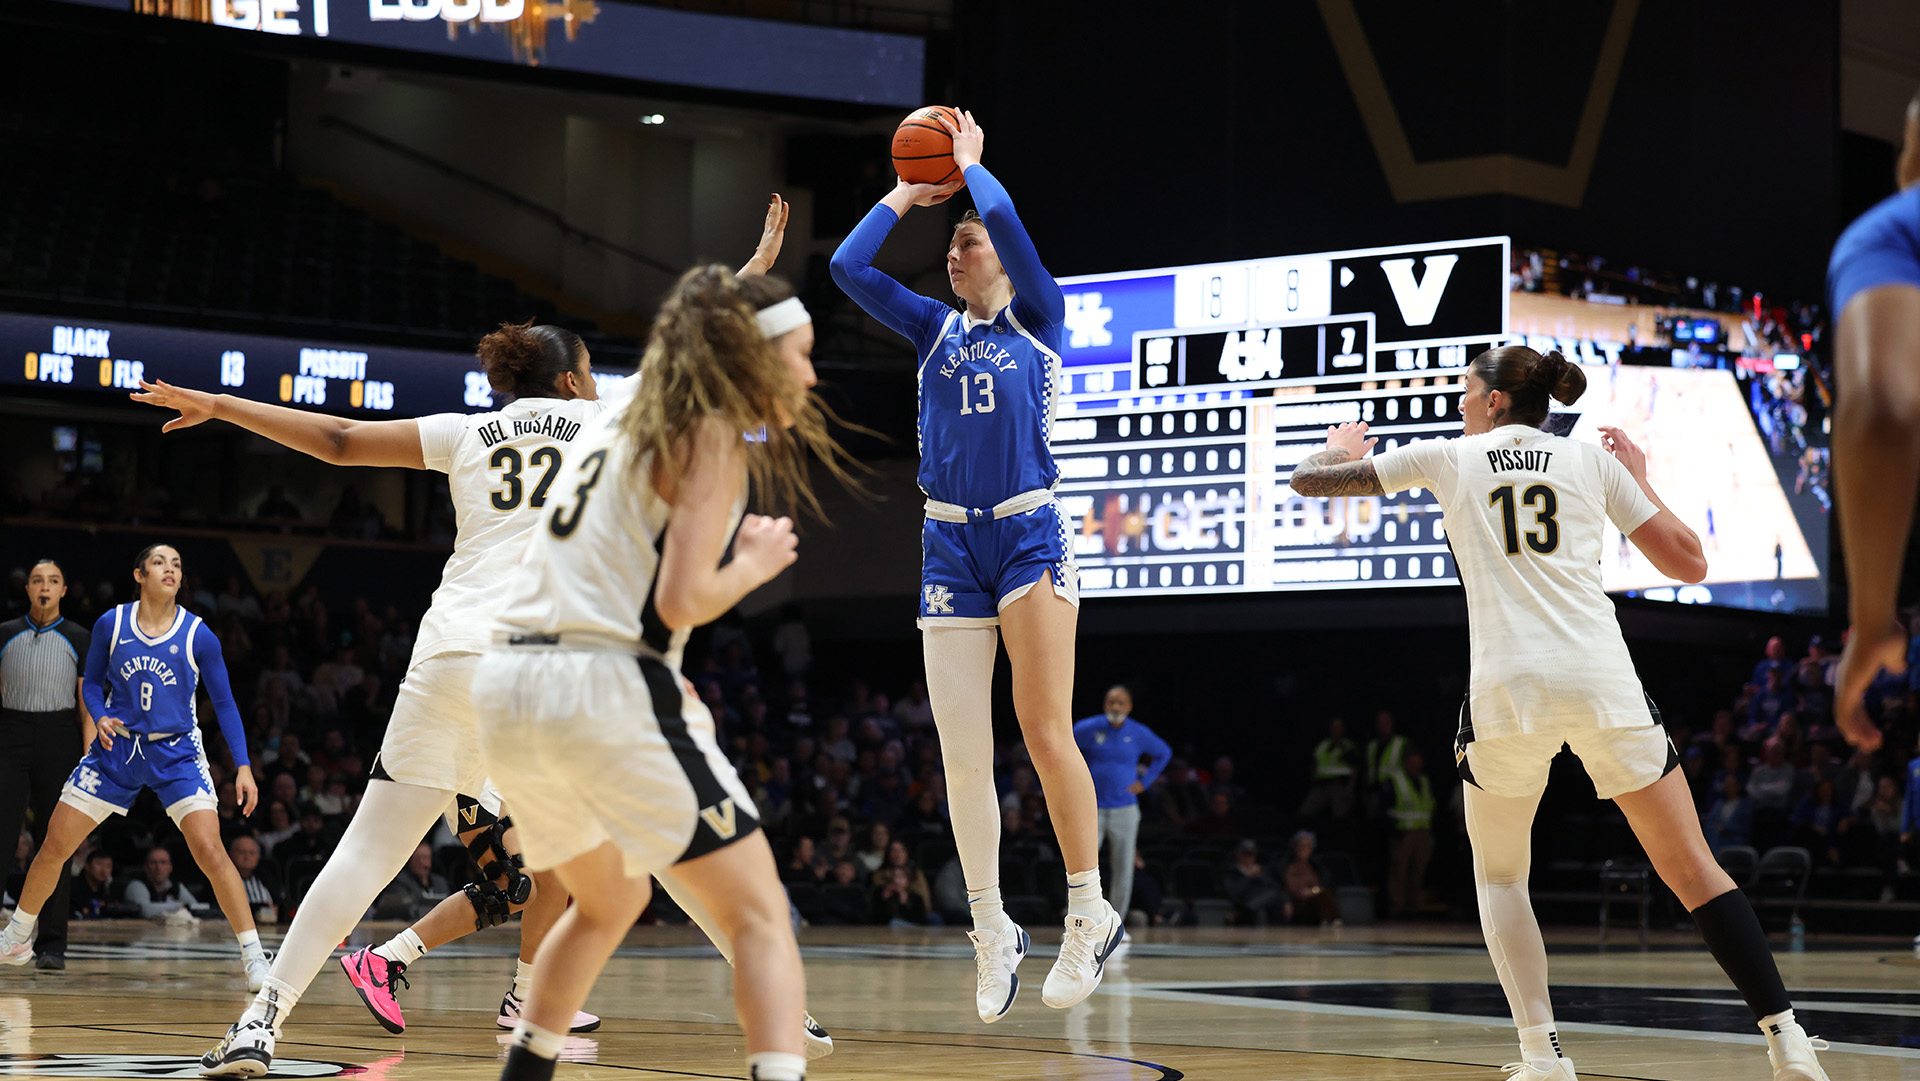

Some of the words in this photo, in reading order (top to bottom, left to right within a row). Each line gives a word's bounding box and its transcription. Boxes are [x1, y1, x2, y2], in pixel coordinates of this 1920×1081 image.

[1379, 254, 1459, 326] V
[53, 326, 110, 358] BLACK
[939, 341, 1018, 379] KENTUCKY
[25, 352, 38, 380] 0
[39, 353, 74, 383] PTS
[99, 358, 113, 386] 0
[114, 359, 144, 389] FLS
[220, 350, 245, 387] 13
[300, 348, 368, 380] PISSOTT
[279, 373, 293, 402] 0
[294, 374, 326, 405] PTS
[350, 379, 363, 408] 0
[364, 380, 394, 410] FLS
[959, 372, 996, 416] 13
[478, 420, 508, 448] DEL
[513, 415, 581, 442] ROSARIO
[489, 445, 564, 512] 32
[1486, 449, 1553, 473] PISSOTT
[548, 446, 608, 541] 3
[1488, 483, 1560, 556] 13
[924, 585, 954, 614] UK
[120, 656, 177, 687] KENTUCKY
[140, 681, 153, 711] 8
[459, 804, 479, 825] V
[701, 800, 736, 840] V
